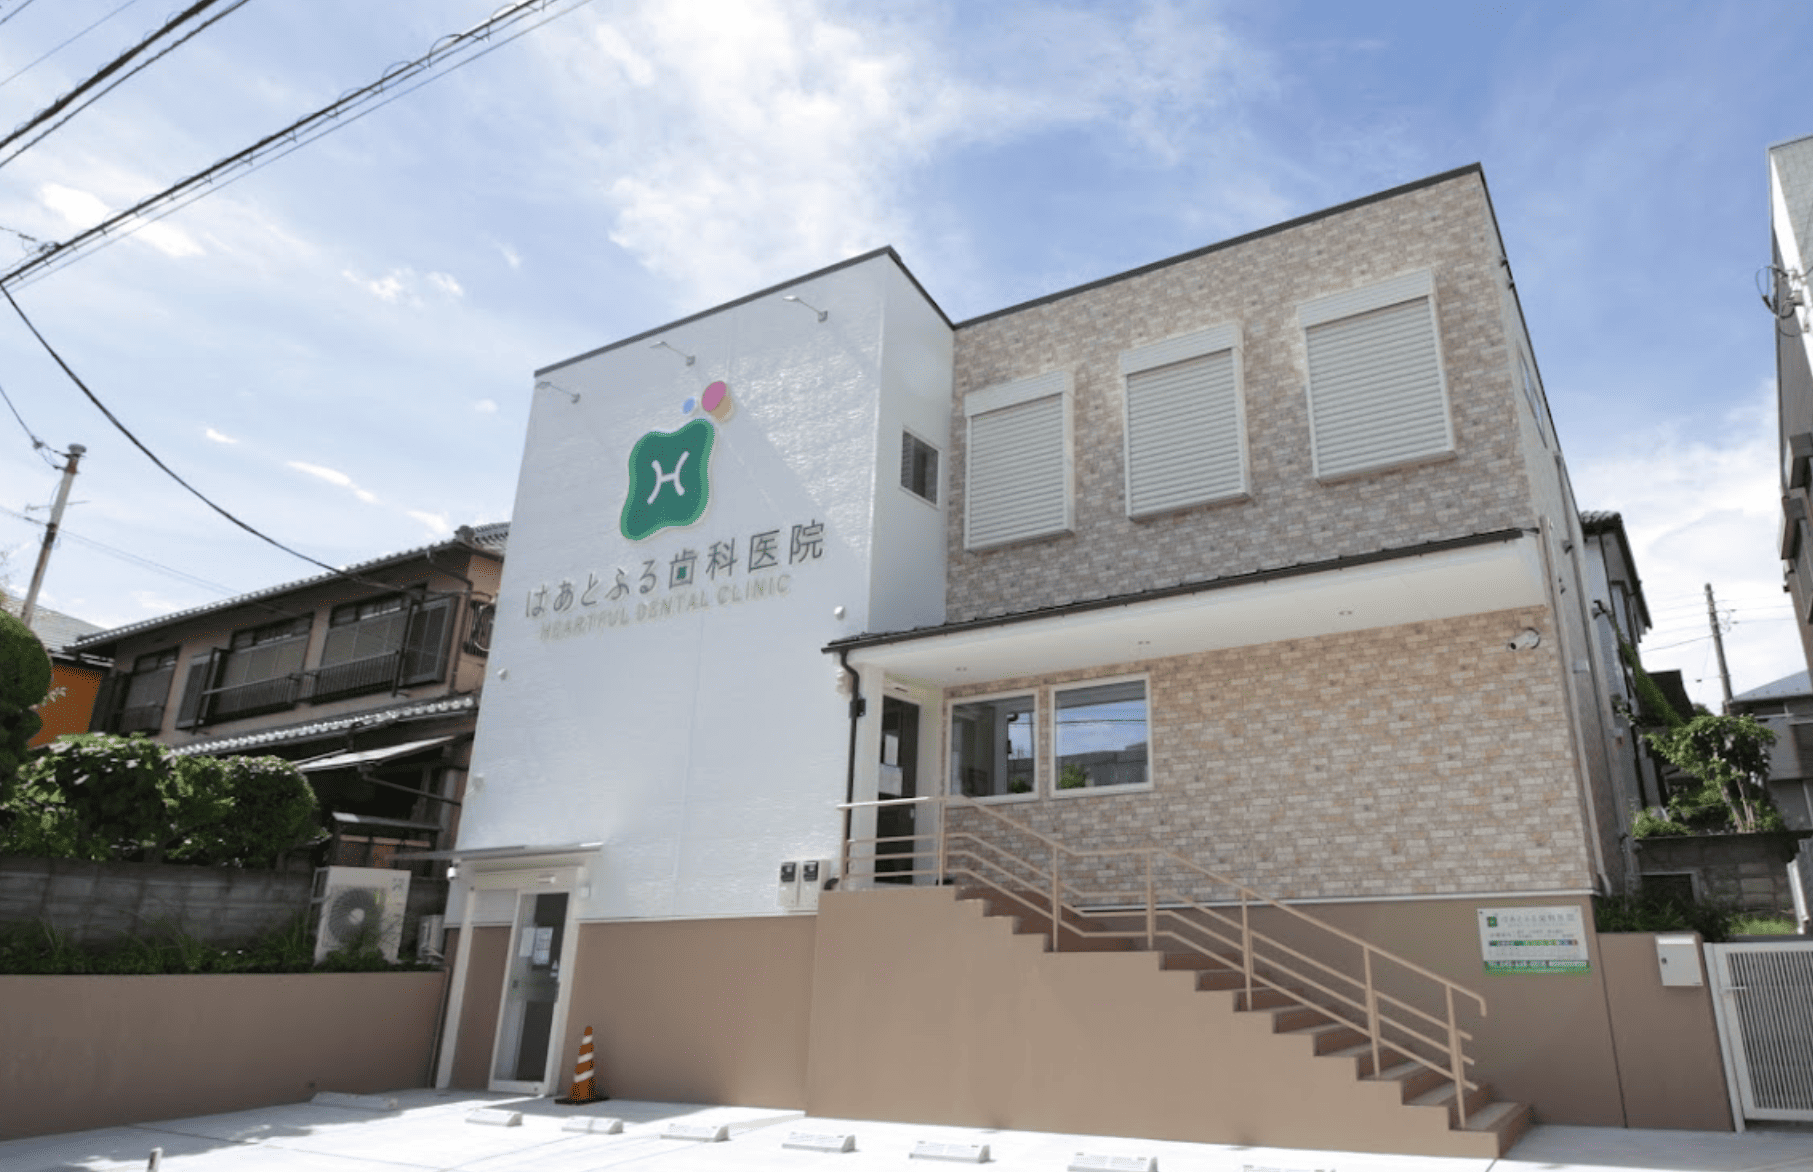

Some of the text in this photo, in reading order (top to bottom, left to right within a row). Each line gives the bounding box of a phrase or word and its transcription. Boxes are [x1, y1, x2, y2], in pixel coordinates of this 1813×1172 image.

[647, 450, 689, 505] H
[525, 519, 825, 617] はあとふる歯科医院
[540, 574, 791, 641] HEARTFUL DENTAL CLINIC
